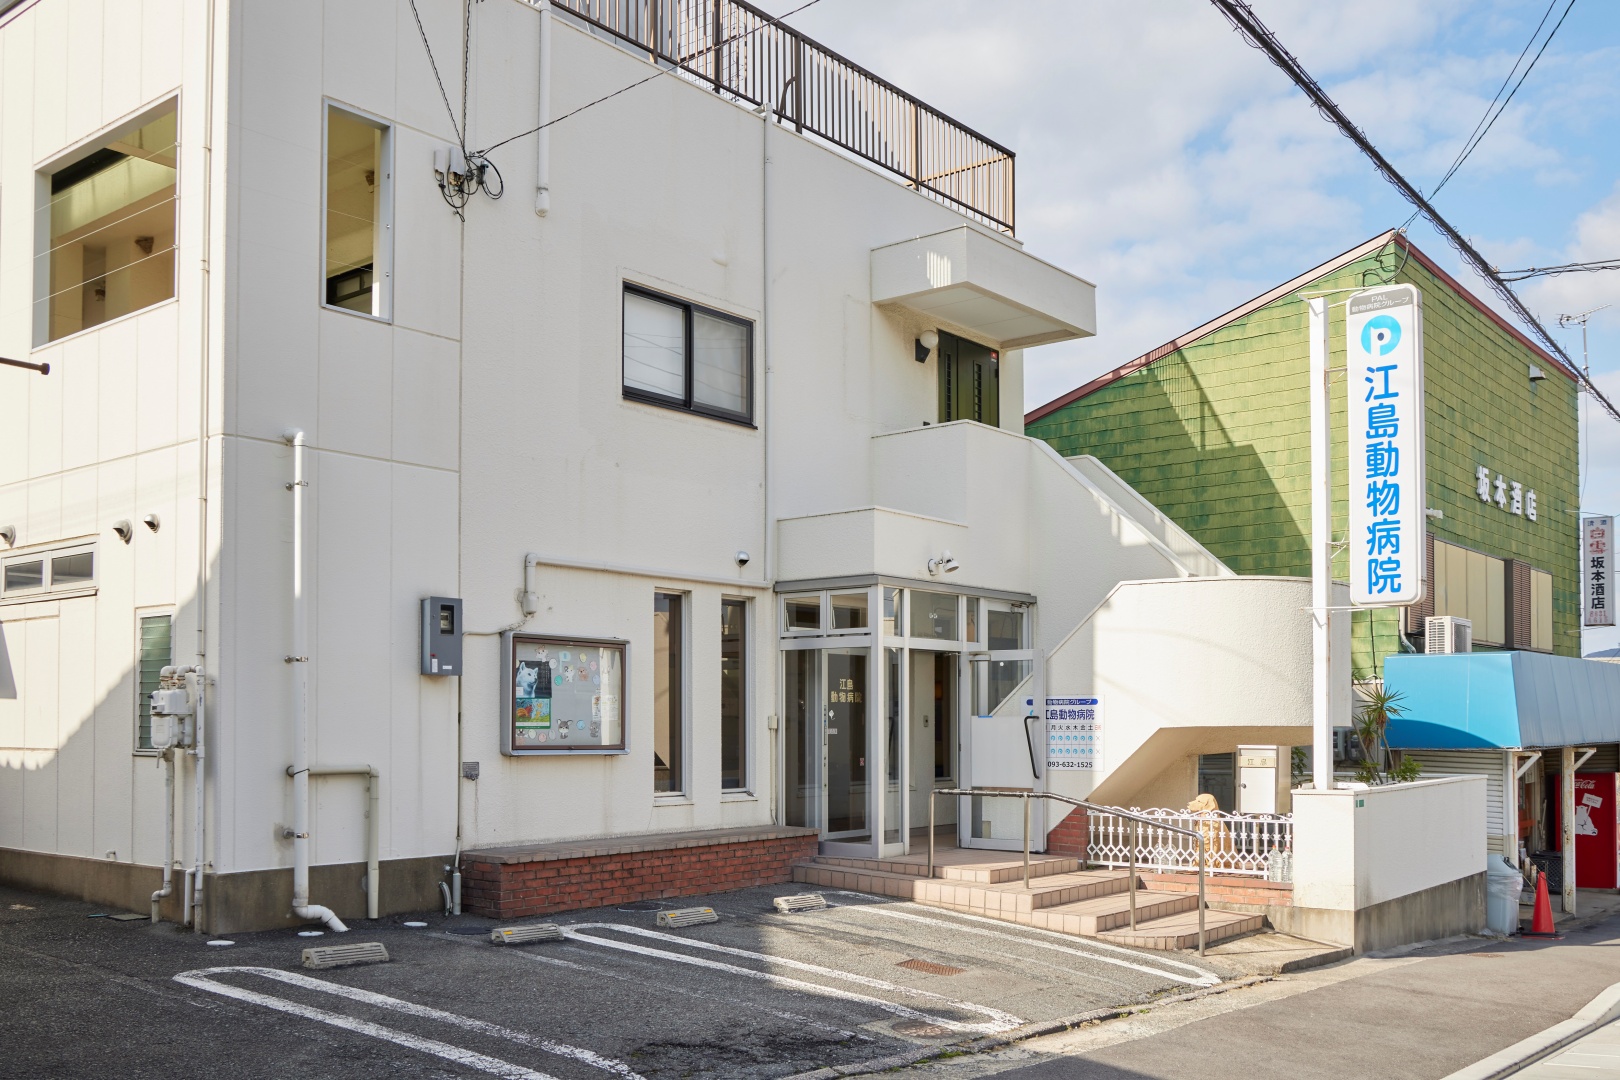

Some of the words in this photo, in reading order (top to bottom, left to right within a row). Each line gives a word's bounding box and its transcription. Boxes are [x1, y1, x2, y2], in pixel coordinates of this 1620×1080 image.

[1352, 296, 1409, 312] 動物病院グループ
[1364, 364, 1402, 595] 江島動物病院
[1476, 465, 1537, 522] 坂本酒店
[1590, 556, 1605, 609] 坂本酒店
[830, 691, 862, 703] 動物病院
